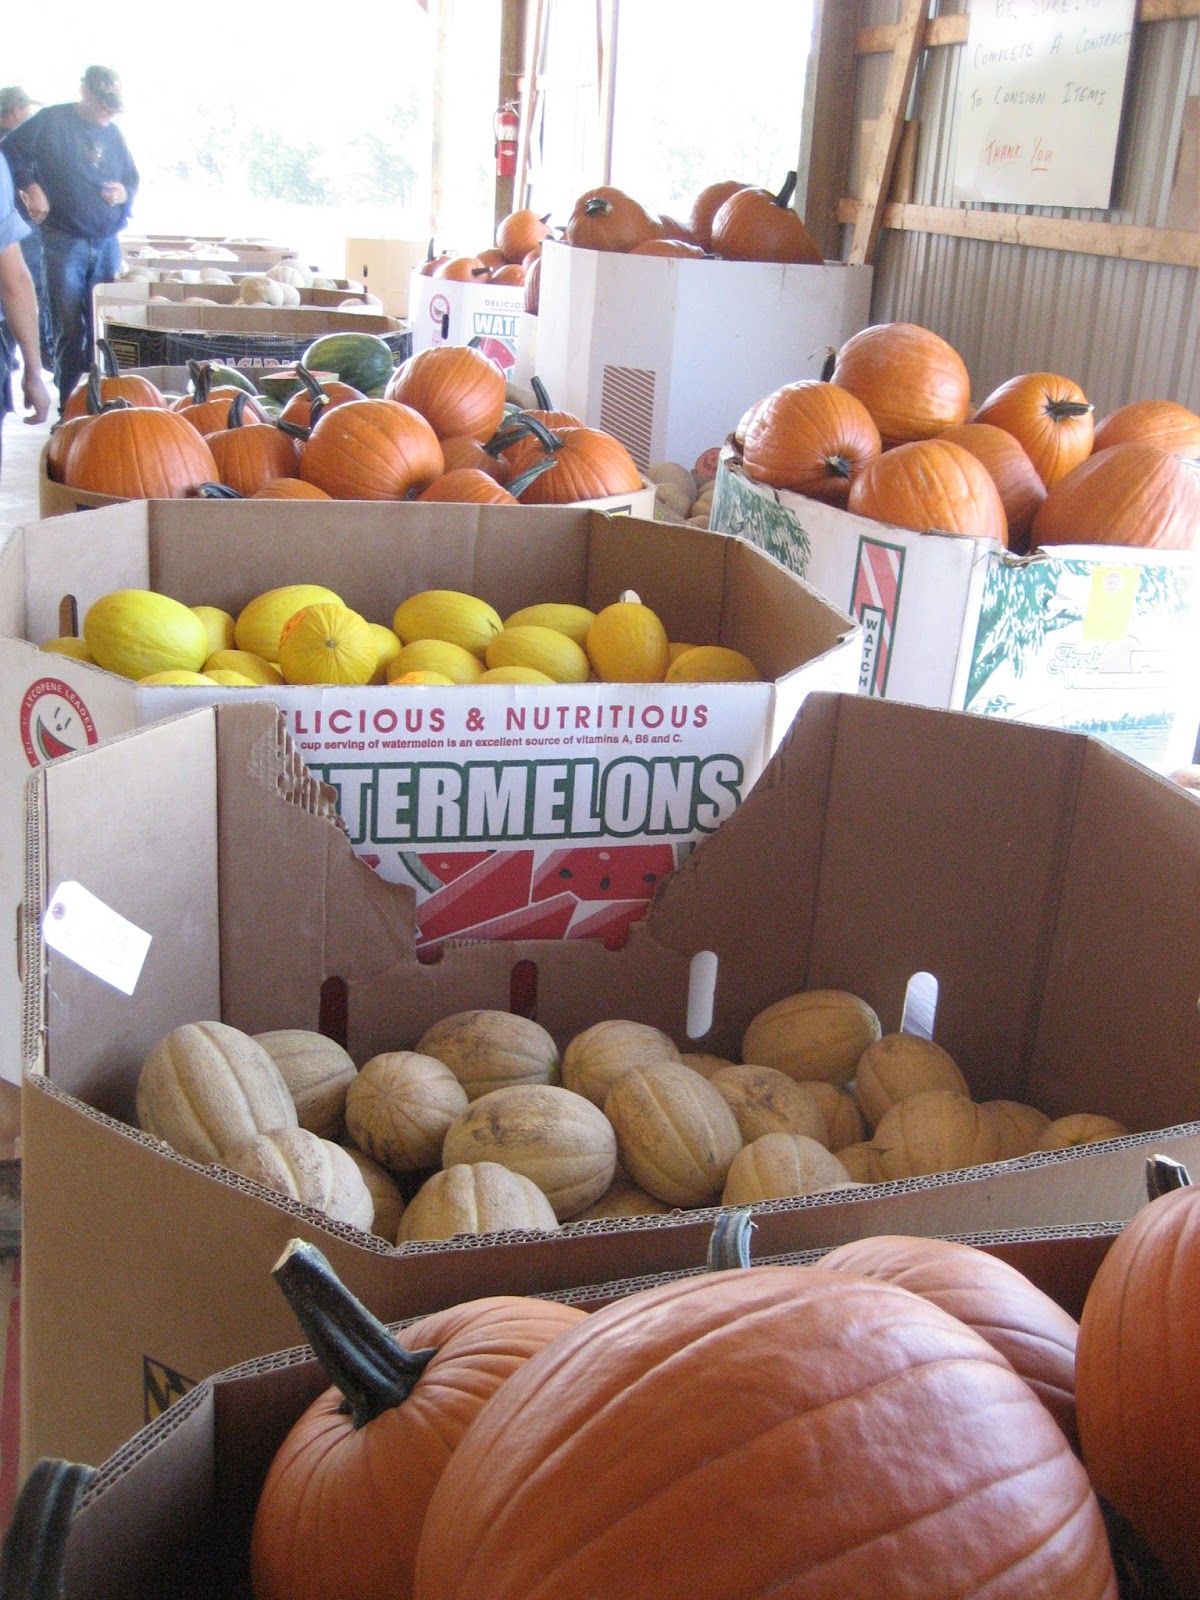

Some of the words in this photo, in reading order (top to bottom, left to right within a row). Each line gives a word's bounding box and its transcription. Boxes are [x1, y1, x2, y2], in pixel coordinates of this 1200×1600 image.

[974, 41, 1035, 69] COMPLETE
[1050, 32, 1063, 55] A
[1076, 27, 1131, 54] CONTRACT
[994, 86, 1046, 105] CONSIGN
[1063, 81, 1107, 106] ITEMS
[985, 138, 1021, 165] THANK
[858, 618, 878, 687] WATCH
[25, 682, 62, 708] LYCOPENE
[65, 689, 93, 733] LEADER
[281, 705, 446, 735] LICIOUS
[465, 706, 486, 732] &
[506, 704, 709, 731] NUTRITIOUS
[300, 741, 322, 751] cup
[324, 739, 364, 751] serving
[368, 738, 379, 749] of
[382, 737, 444, 749] watermelon
[447, 737, 457, 748] is
[459, 739, 472, 748] an
[475, 736, 523, 747] excellent
[525, 737, 560, 746] source
[563, 735, 574, 745] of
[576, 734, 619, 744] vitamins
[621, 734, 633, 745] A,
[635, 734, 649, 744] B6
[651, 734, 670, 744] and
[672, 733, 683, 743] C.
[306, 753, 745, 846] TERMELONS
